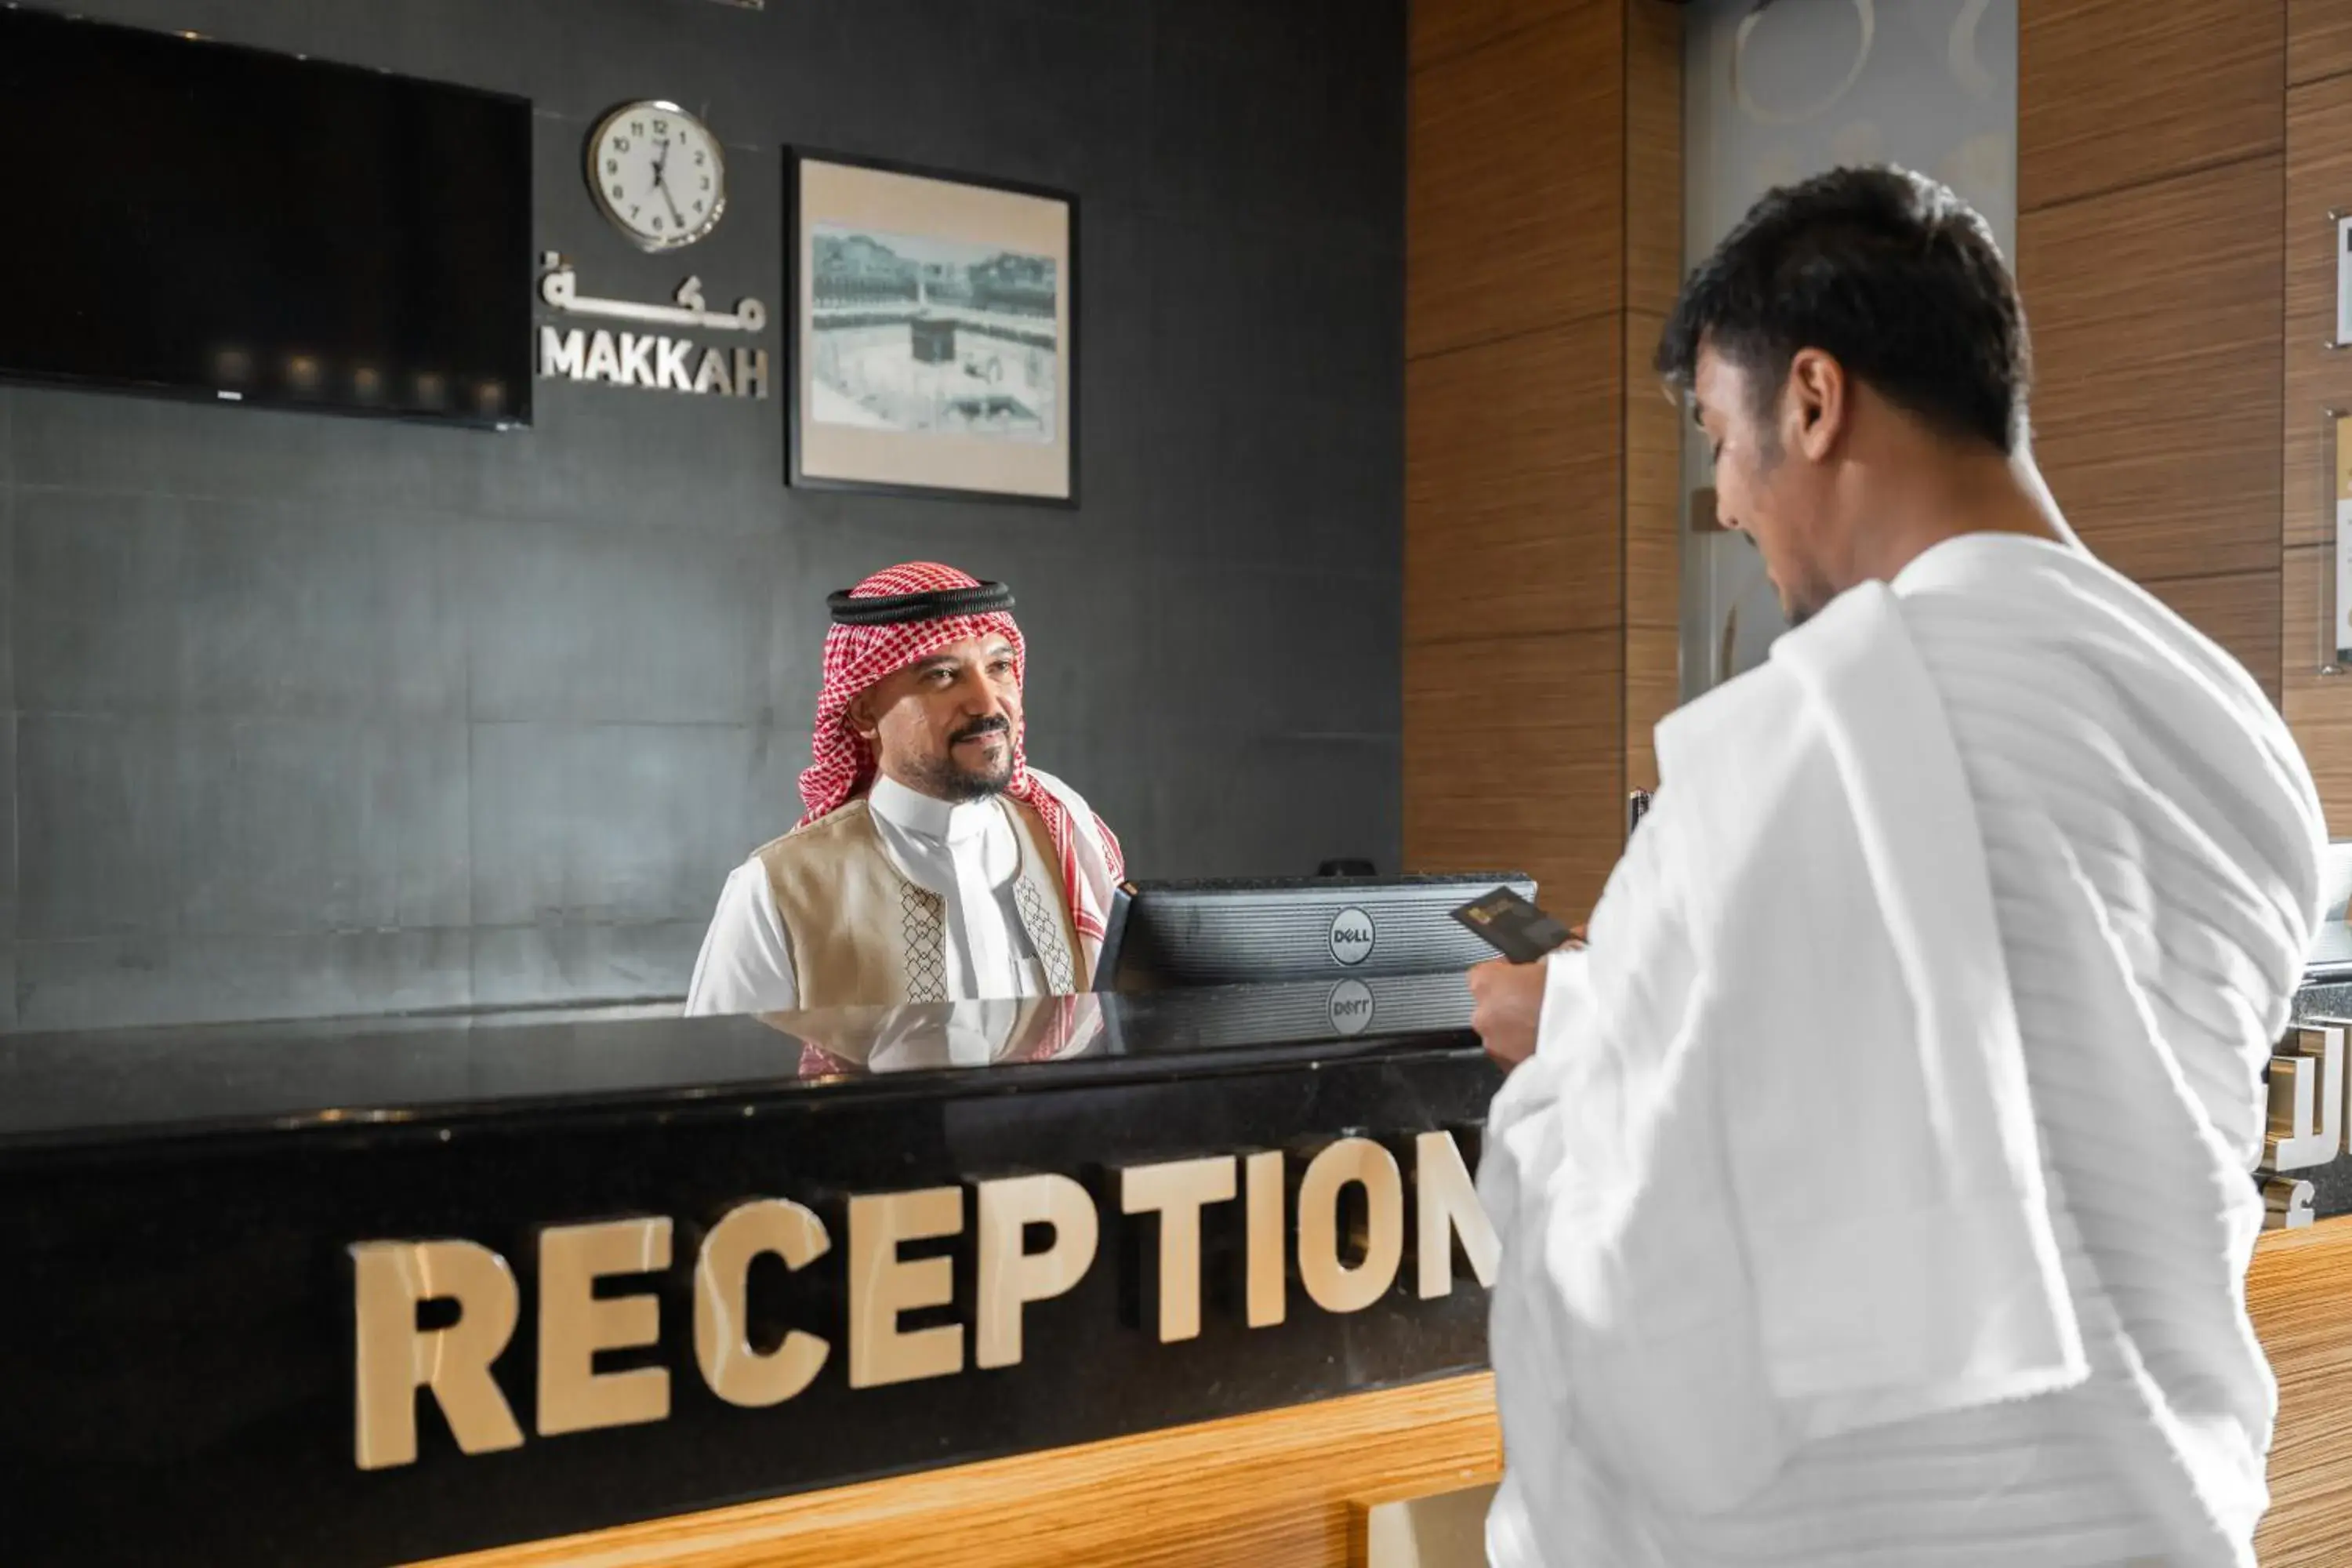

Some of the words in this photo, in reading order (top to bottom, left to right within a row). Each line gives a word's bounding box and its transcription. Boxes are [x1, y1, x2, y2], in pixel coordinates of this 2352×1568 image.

[631, 121, 644, 136] 11
[653, 119, 667, 135] 12
[613, 136, 630, 153] 10
[680, 131, 686, 144] 1
[542, 251, 766, 332] مكة
[539, 325, 768, 398] MAKKAH
[1334, 927, 1370, 942] DELL
[354, 1130, 1503, 1471] RECEPTION
